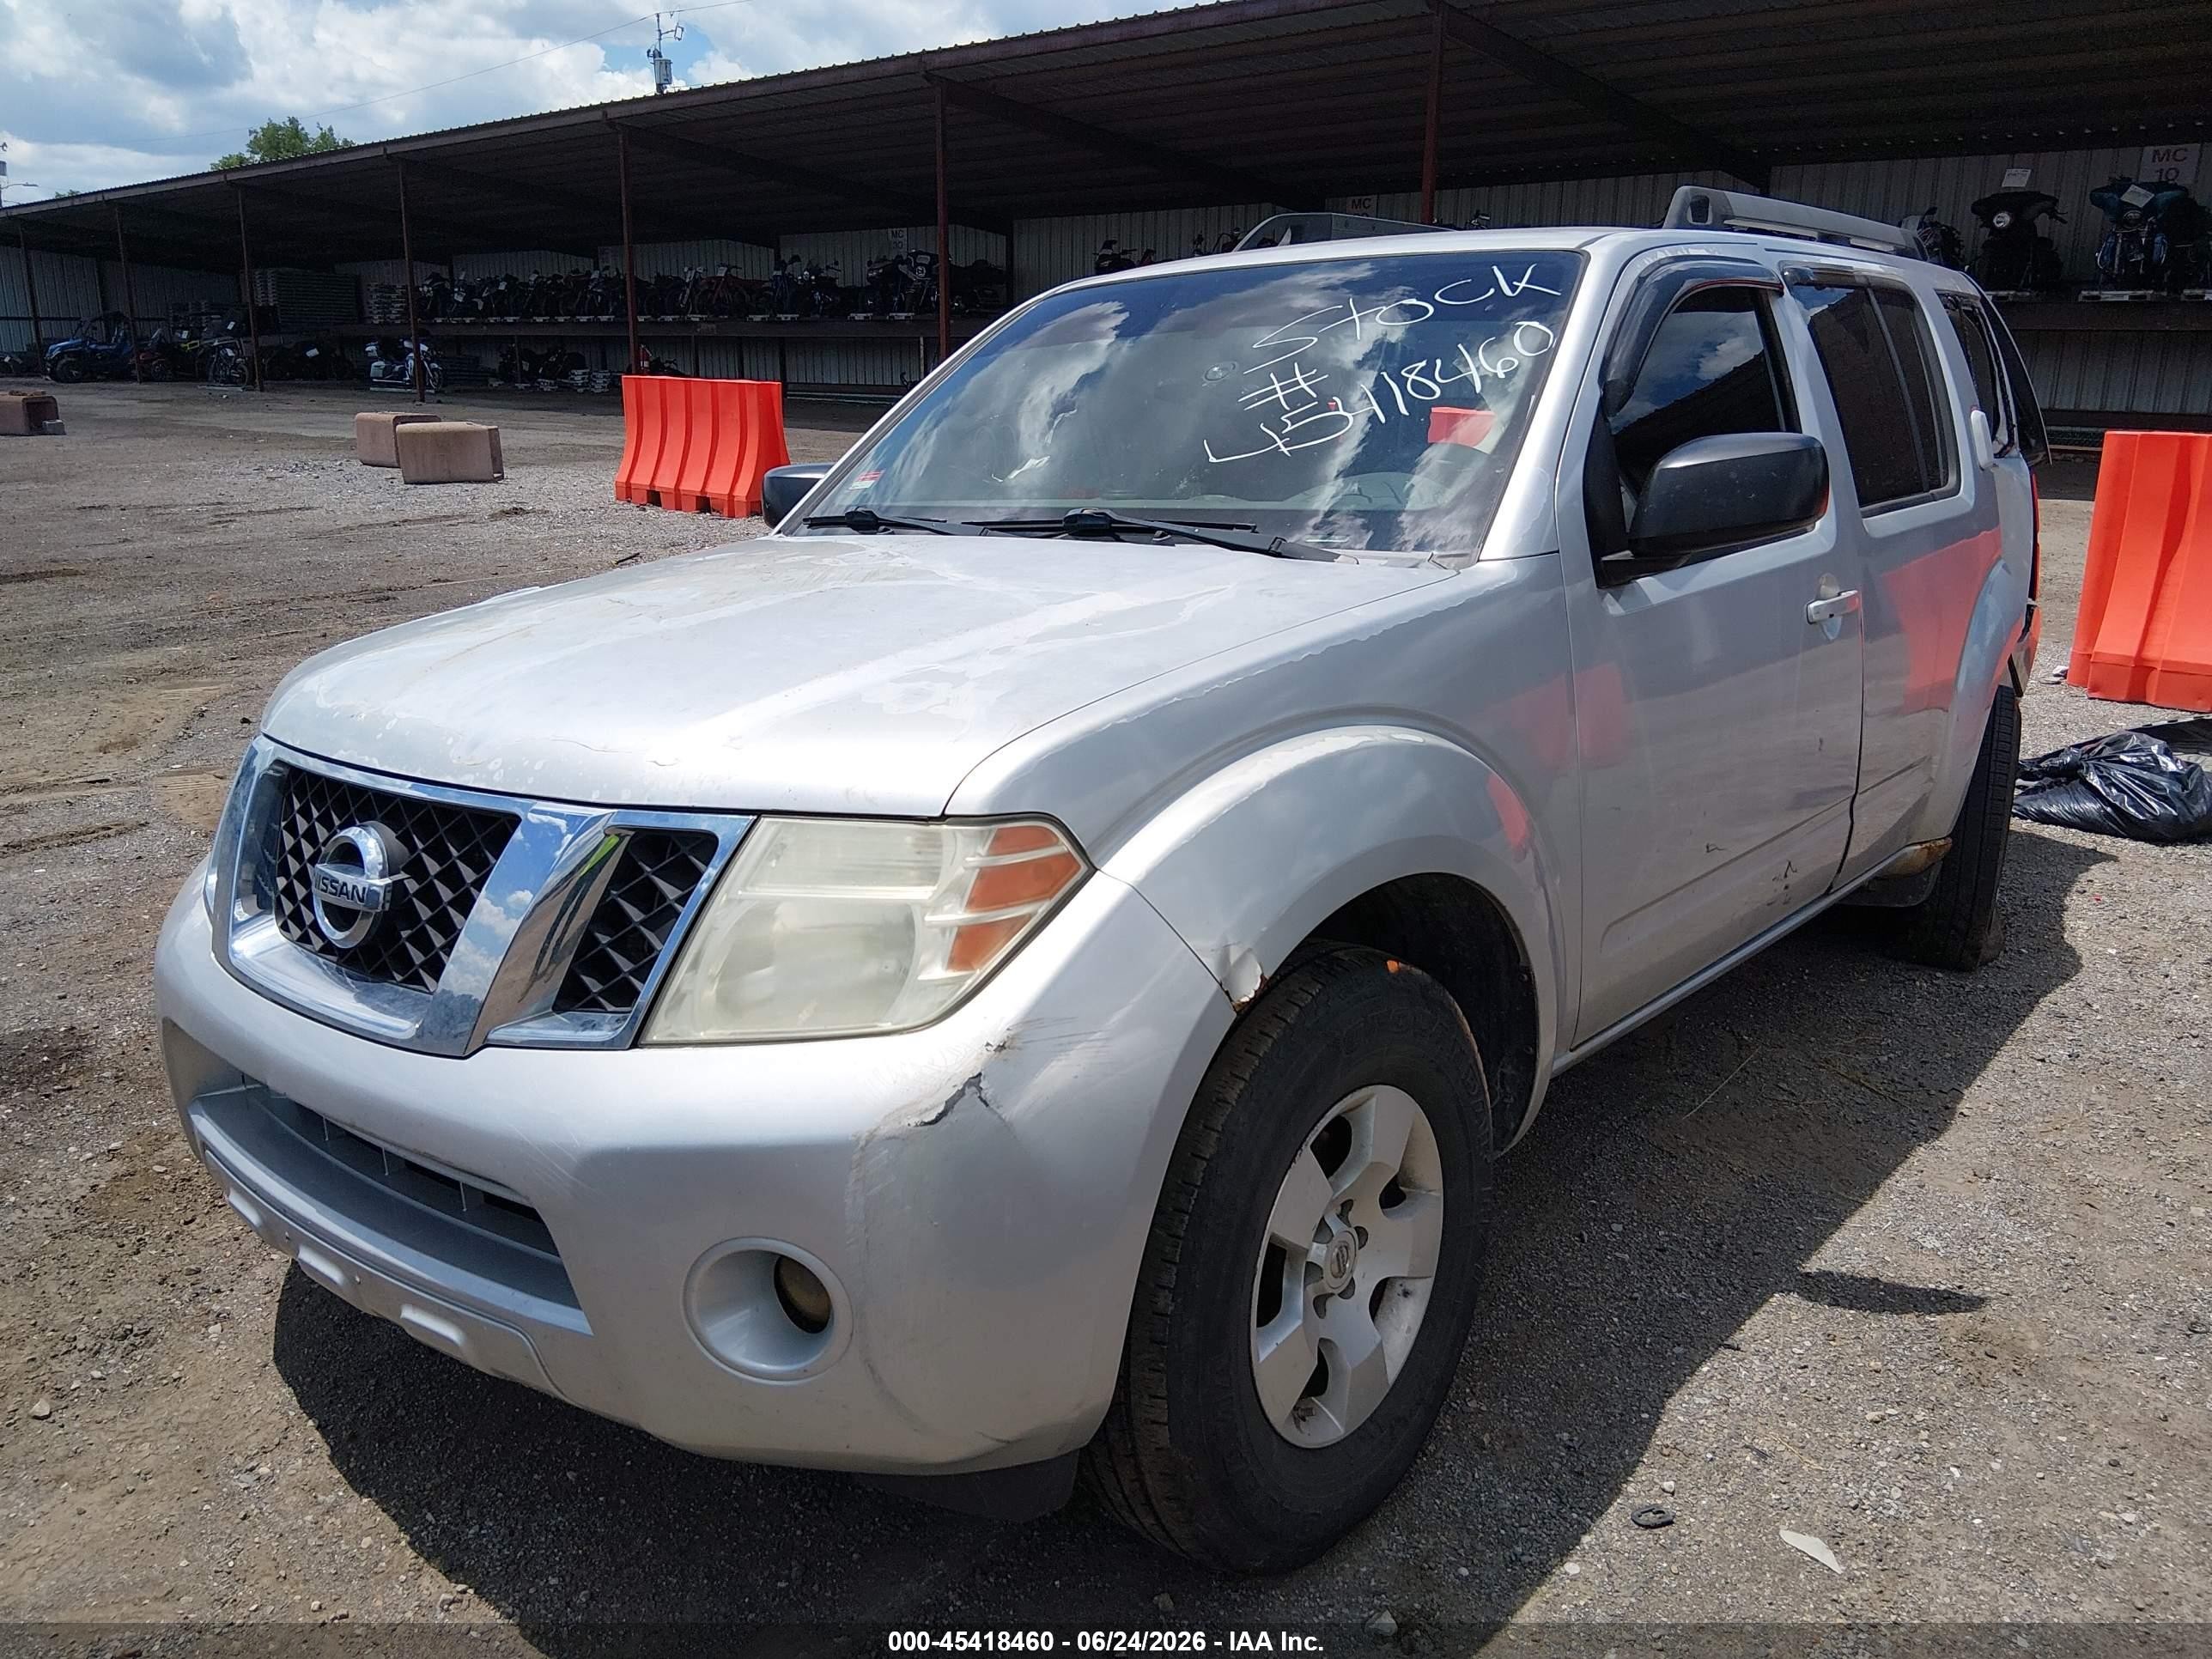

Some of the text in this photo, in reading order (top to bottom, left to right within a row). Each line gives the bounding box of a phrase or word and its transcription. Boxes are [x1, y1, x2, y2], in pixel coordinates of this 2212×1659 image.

[2151, 148, 2188, 163] MC
[2155, 167, 2180, 180] 10
[1352, 198, 1371, 209] MC
[891, 229, 904, 239] MC
[1237, 362, 1329, 411] #
[314, 872, 367, 904] NISSAN
